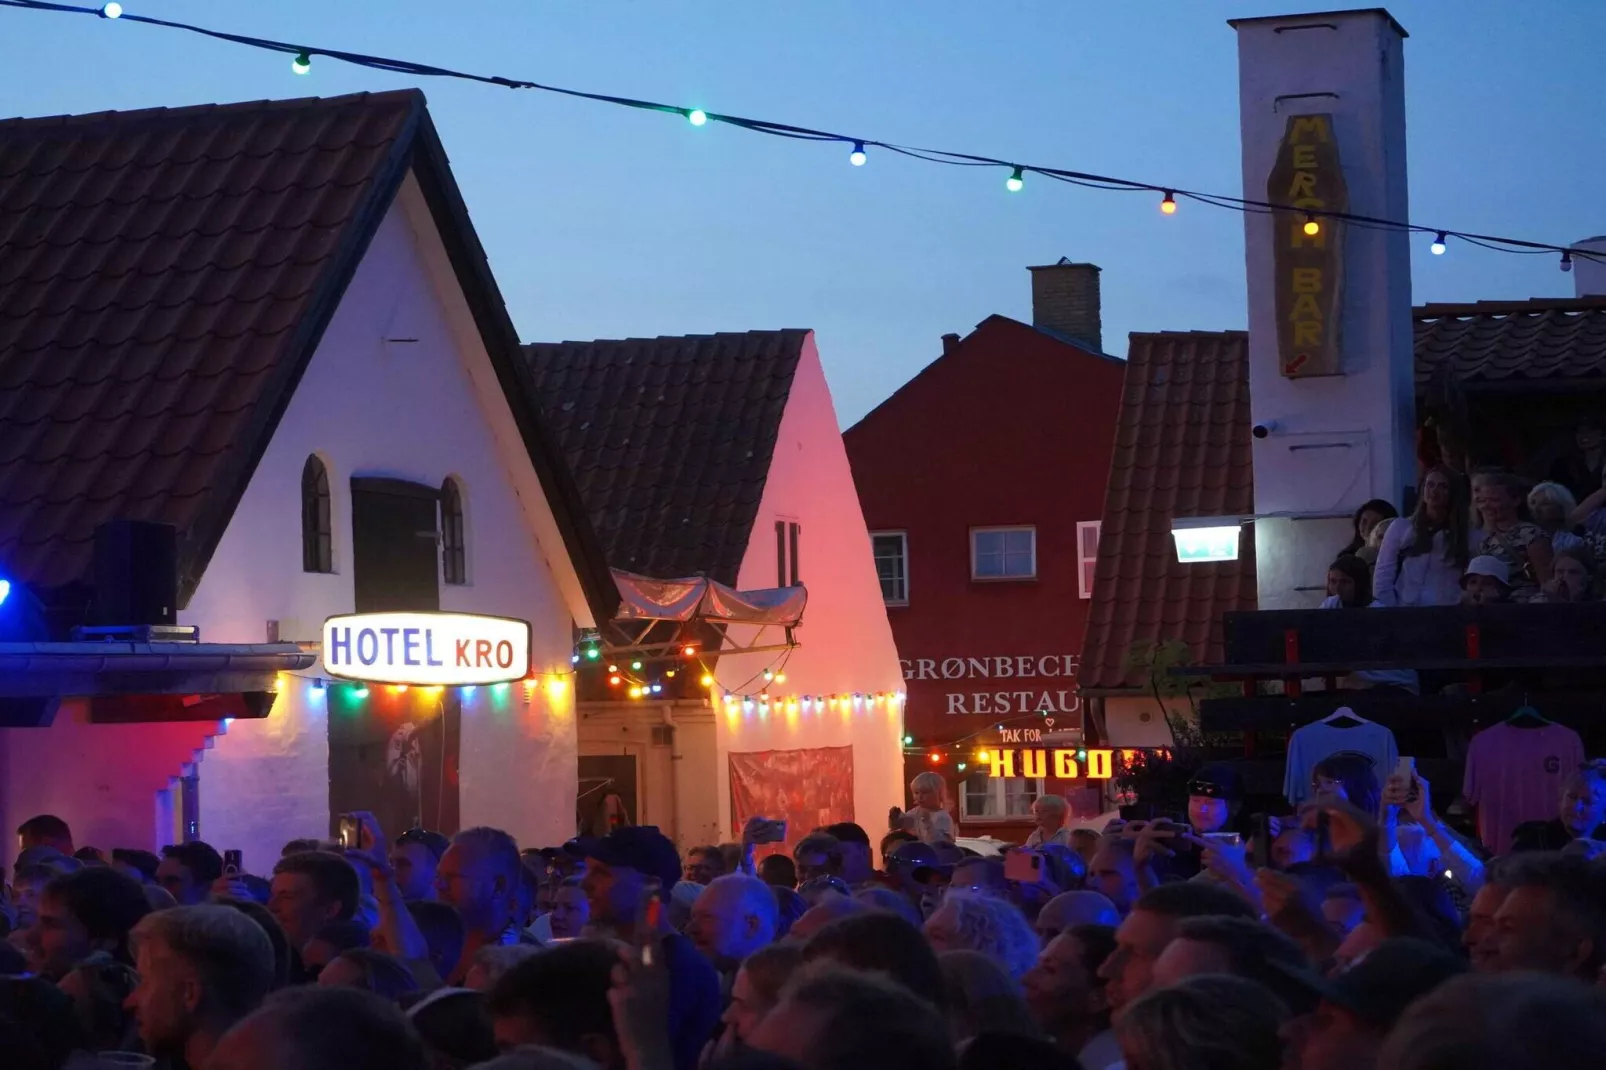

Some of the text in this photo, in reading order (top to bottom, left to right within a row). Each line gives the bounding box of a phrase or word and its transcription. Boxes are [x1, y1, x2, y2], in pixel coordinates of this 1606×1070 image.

[1289, 116, 1328, 347] MERCH BAR
[331, 627, 513, 669] HOTEL KRO
[945, 690, 1080, 715] RESTAU
[1000, 729, 1021, 743] TAK
[1024, 728, 1042, 742] FOR
